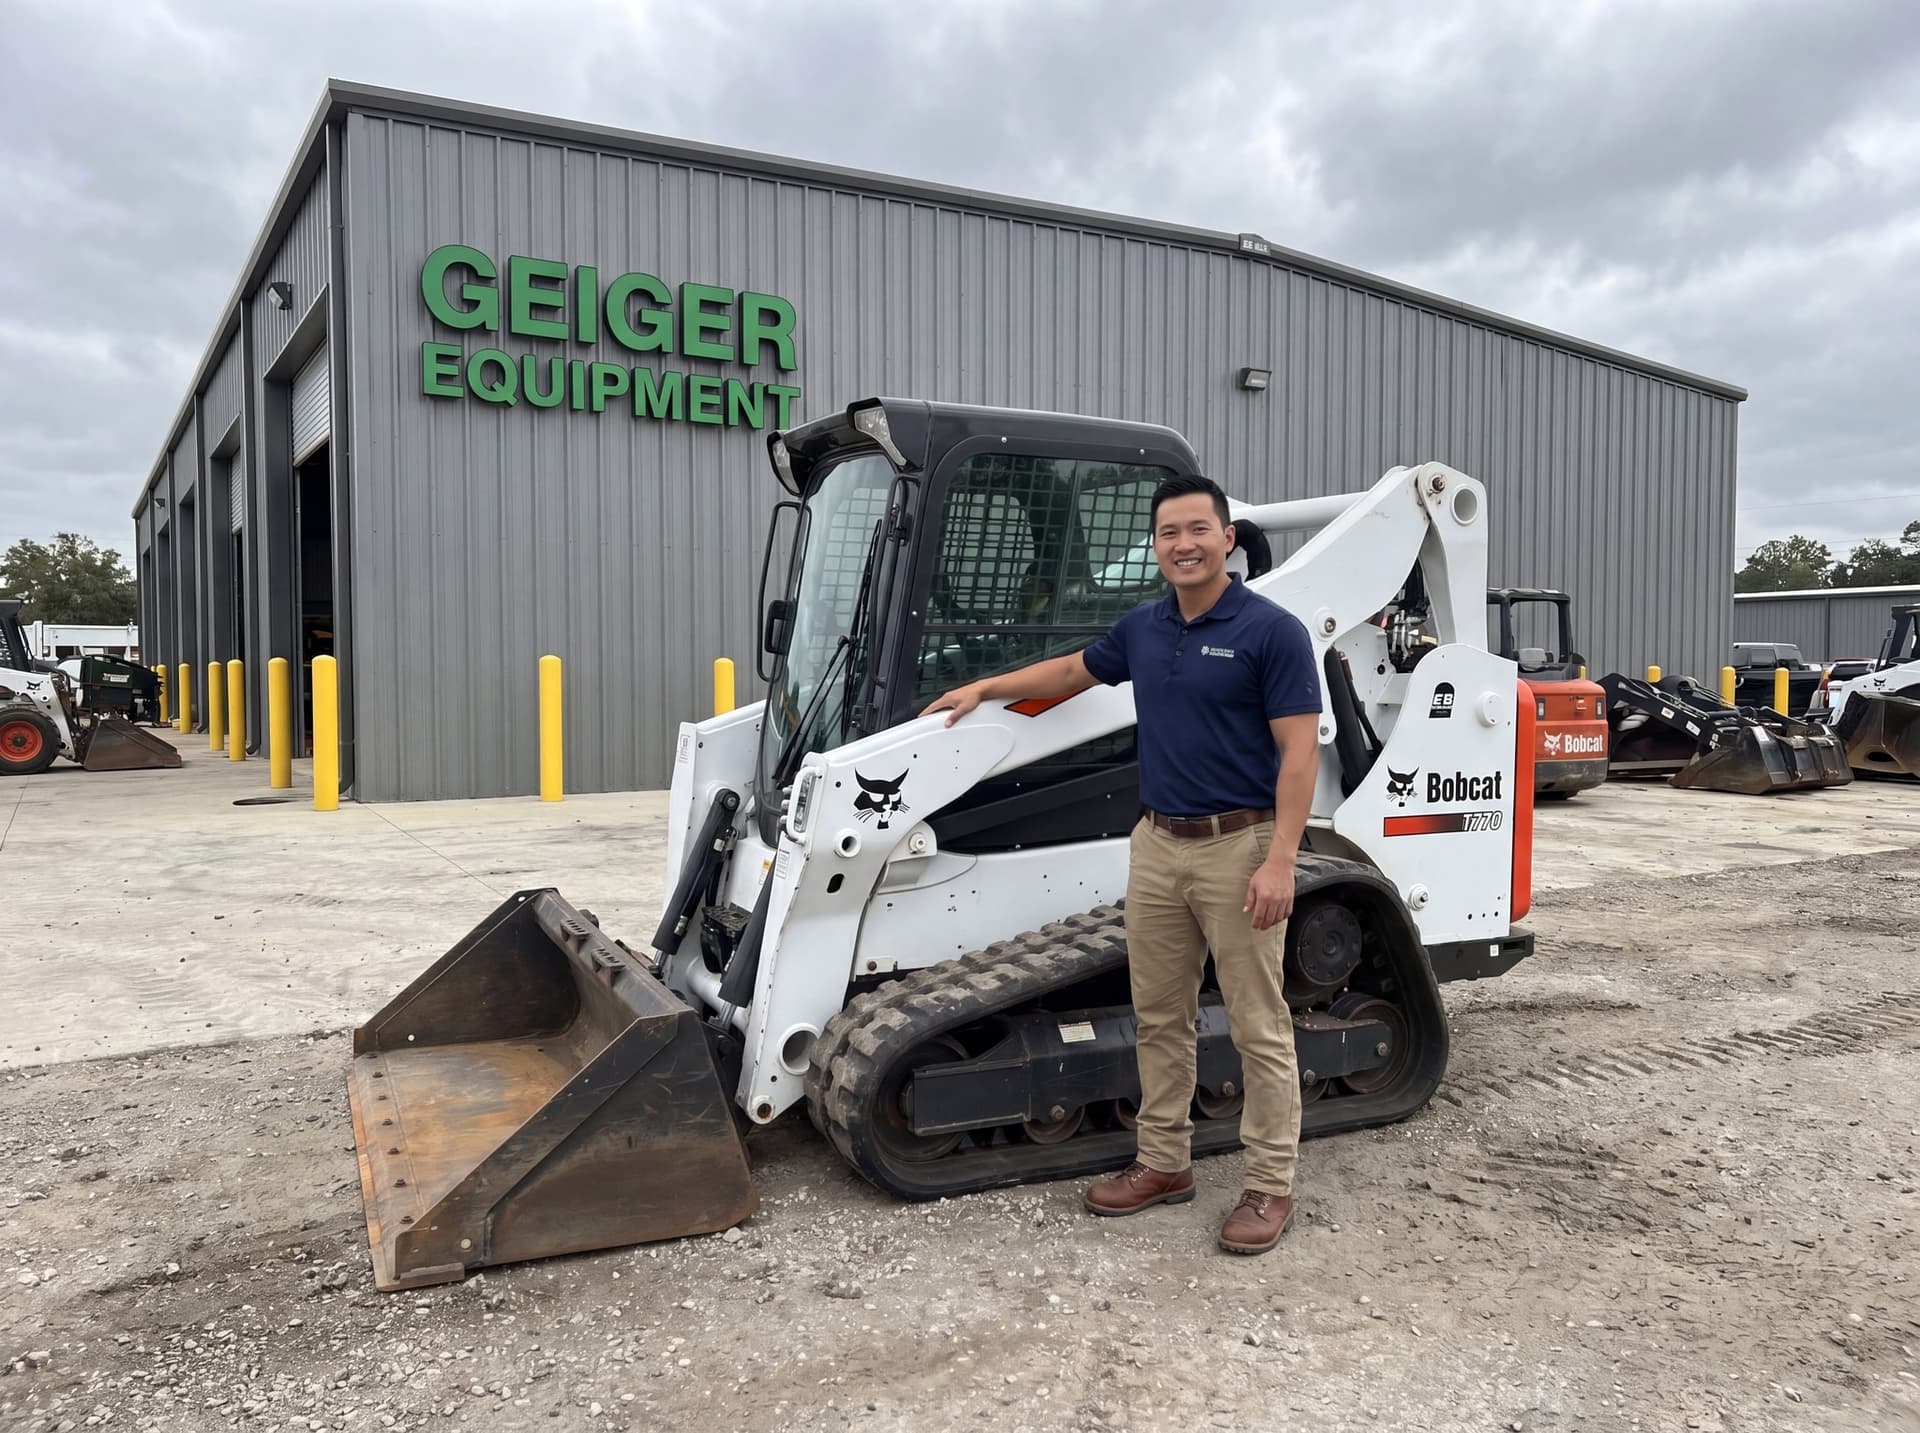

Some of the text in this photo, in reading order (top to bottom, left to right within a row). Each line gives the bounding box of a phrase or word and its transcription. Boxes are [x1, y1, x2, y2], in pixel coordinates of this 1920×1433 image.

[421, 244, 798, 371] GEIGER
[422, 341, 801, 432] EQUIPMENT
[1433, 693, 1454, 705] EB
[1564, 734, 1604, 753] Bobcat
[1427, 771, 1502, 803] Bobcat
[1462, 810, 1503, 832] T770
